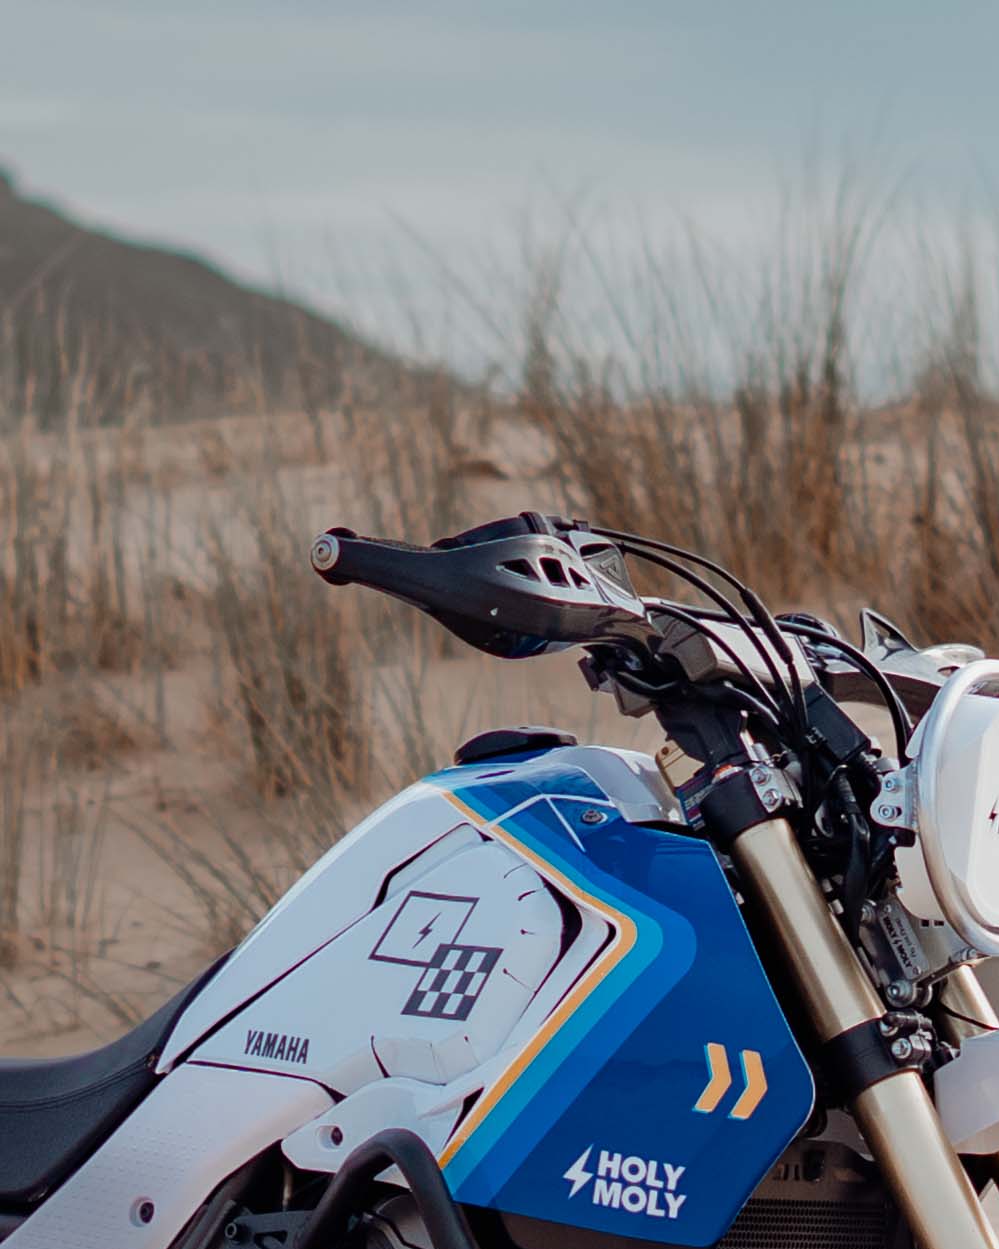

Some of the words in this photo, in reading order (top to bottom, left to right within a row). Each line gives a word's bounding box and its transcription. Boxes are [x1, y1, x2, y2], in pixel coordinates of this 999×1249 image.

[244, 1029, 310, 1065] YAMAHA
[598, 1150, 686, 1191] HOLY
[592, 1178, 687, 1218] MOLY
